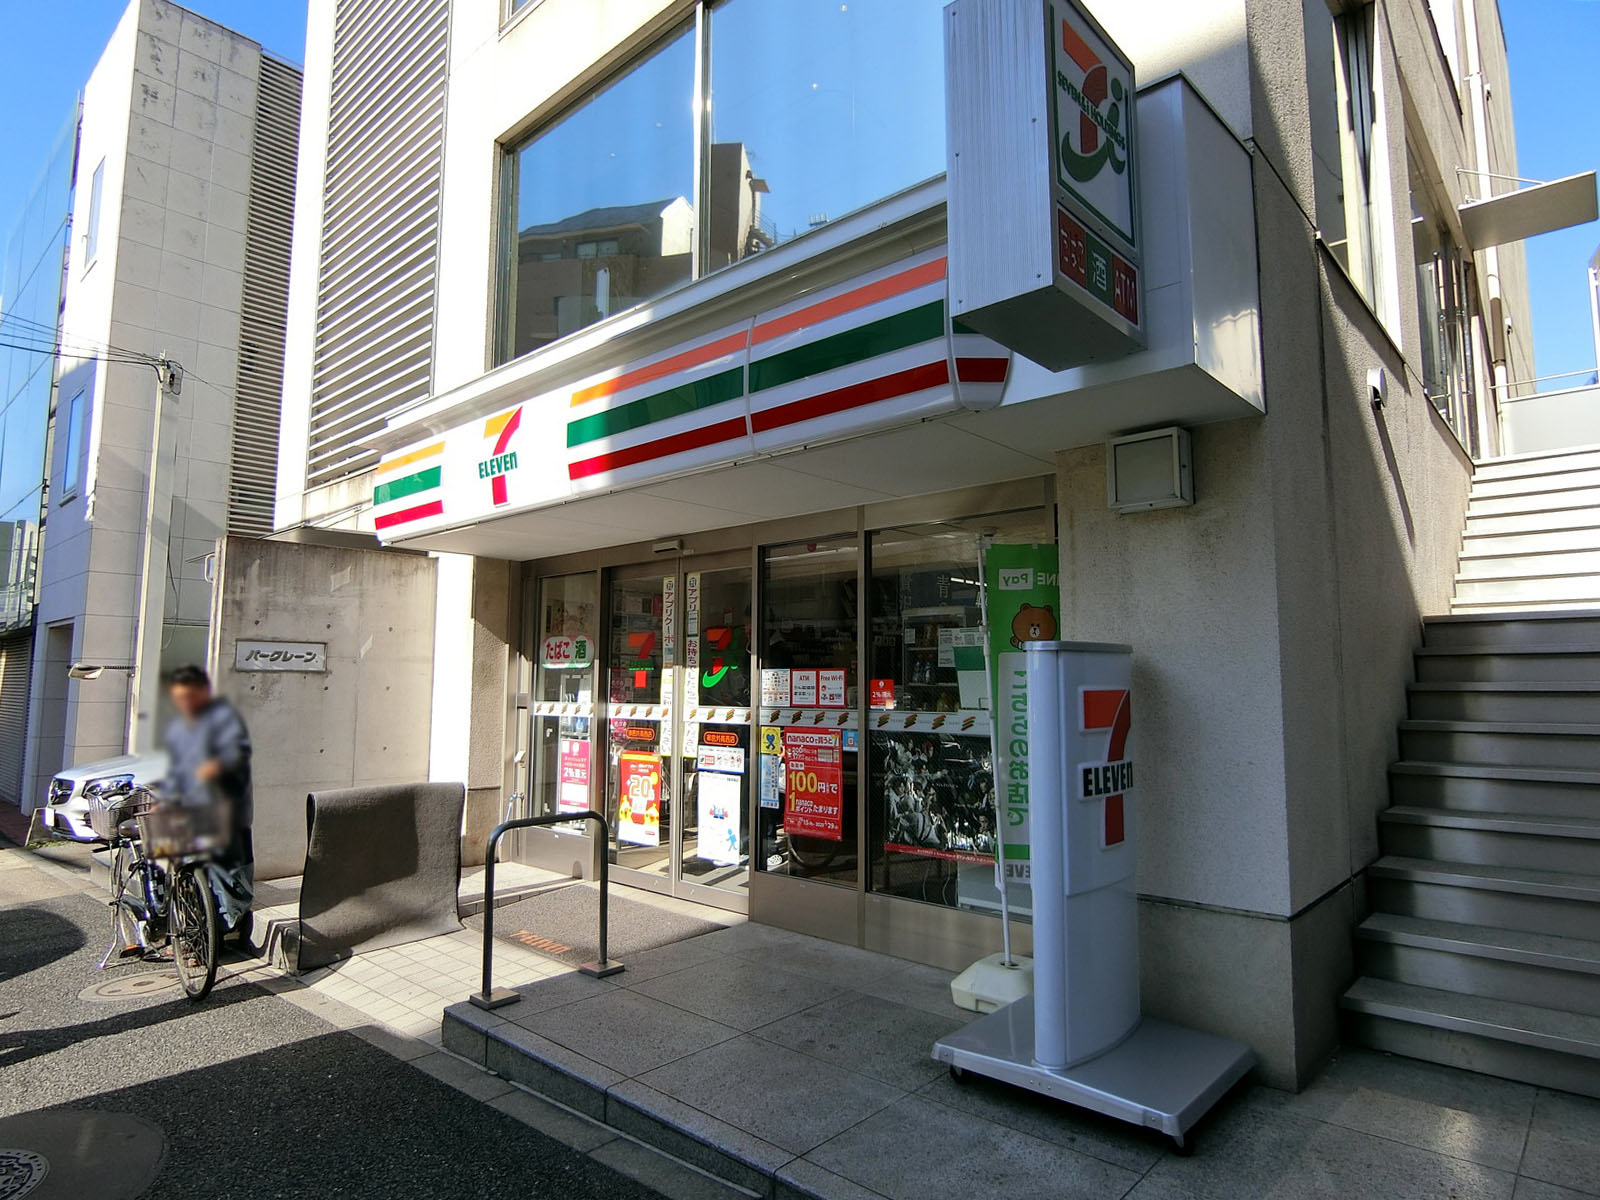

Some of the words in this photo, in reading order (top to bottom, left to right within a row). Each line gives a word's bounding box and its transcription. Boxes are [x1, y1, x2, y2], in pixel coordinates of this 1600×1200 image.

[1091, 249, 1107, 292] 酒
[1114, 269, 1136, 312] ATM
[244, 649, 317, 663] パークレーン
[545, 641, 570, 660] たばこ
[574, 639, 587, 659] 酒
